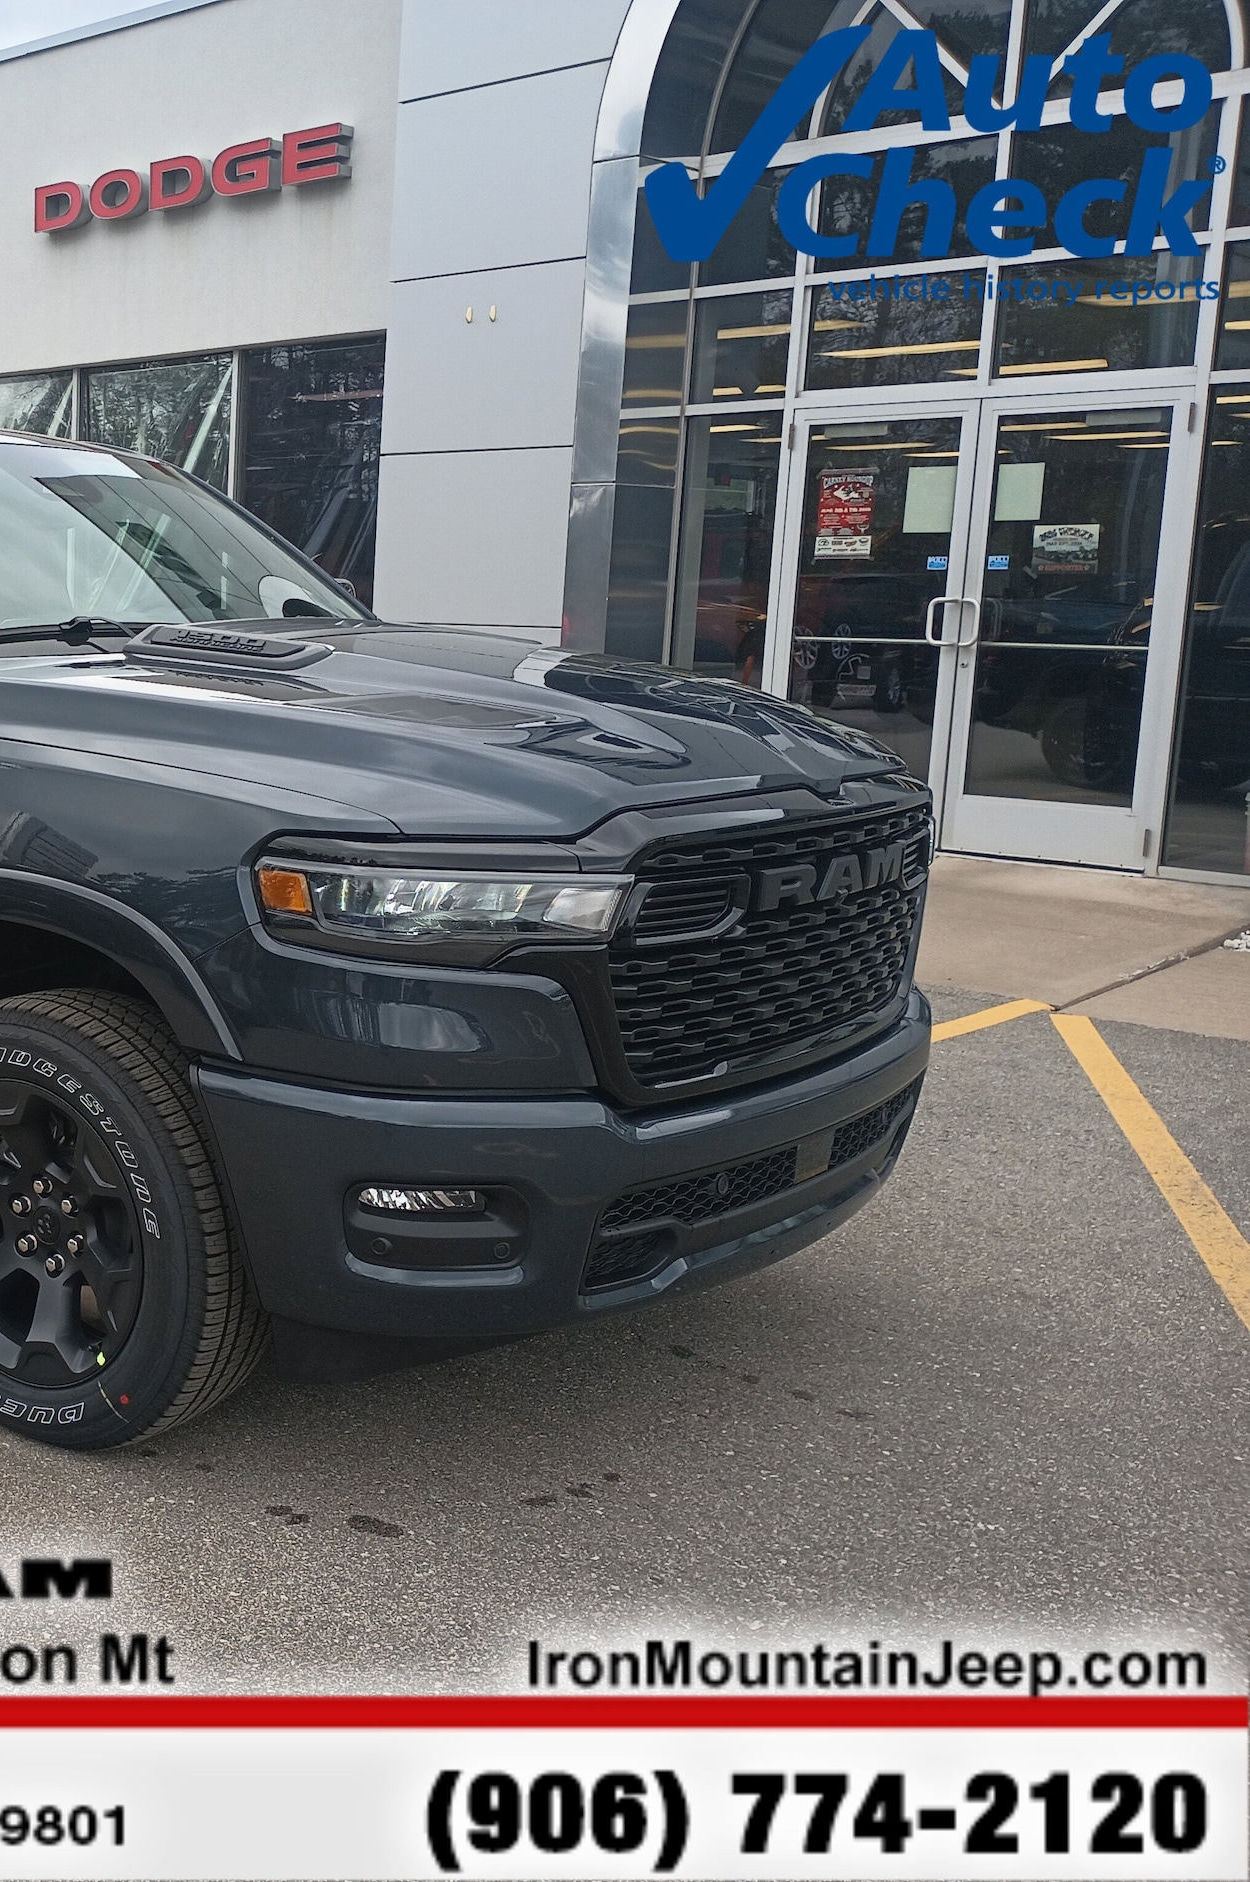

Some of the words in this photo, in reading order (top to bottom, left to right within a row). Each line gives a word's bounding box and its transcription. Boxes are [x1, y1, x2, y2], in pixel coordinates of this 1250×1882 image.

[35, 122, 353, 233] DODGE
[177, 629, 267, 648] 1500
[758, 840, 906, 912] RAM
